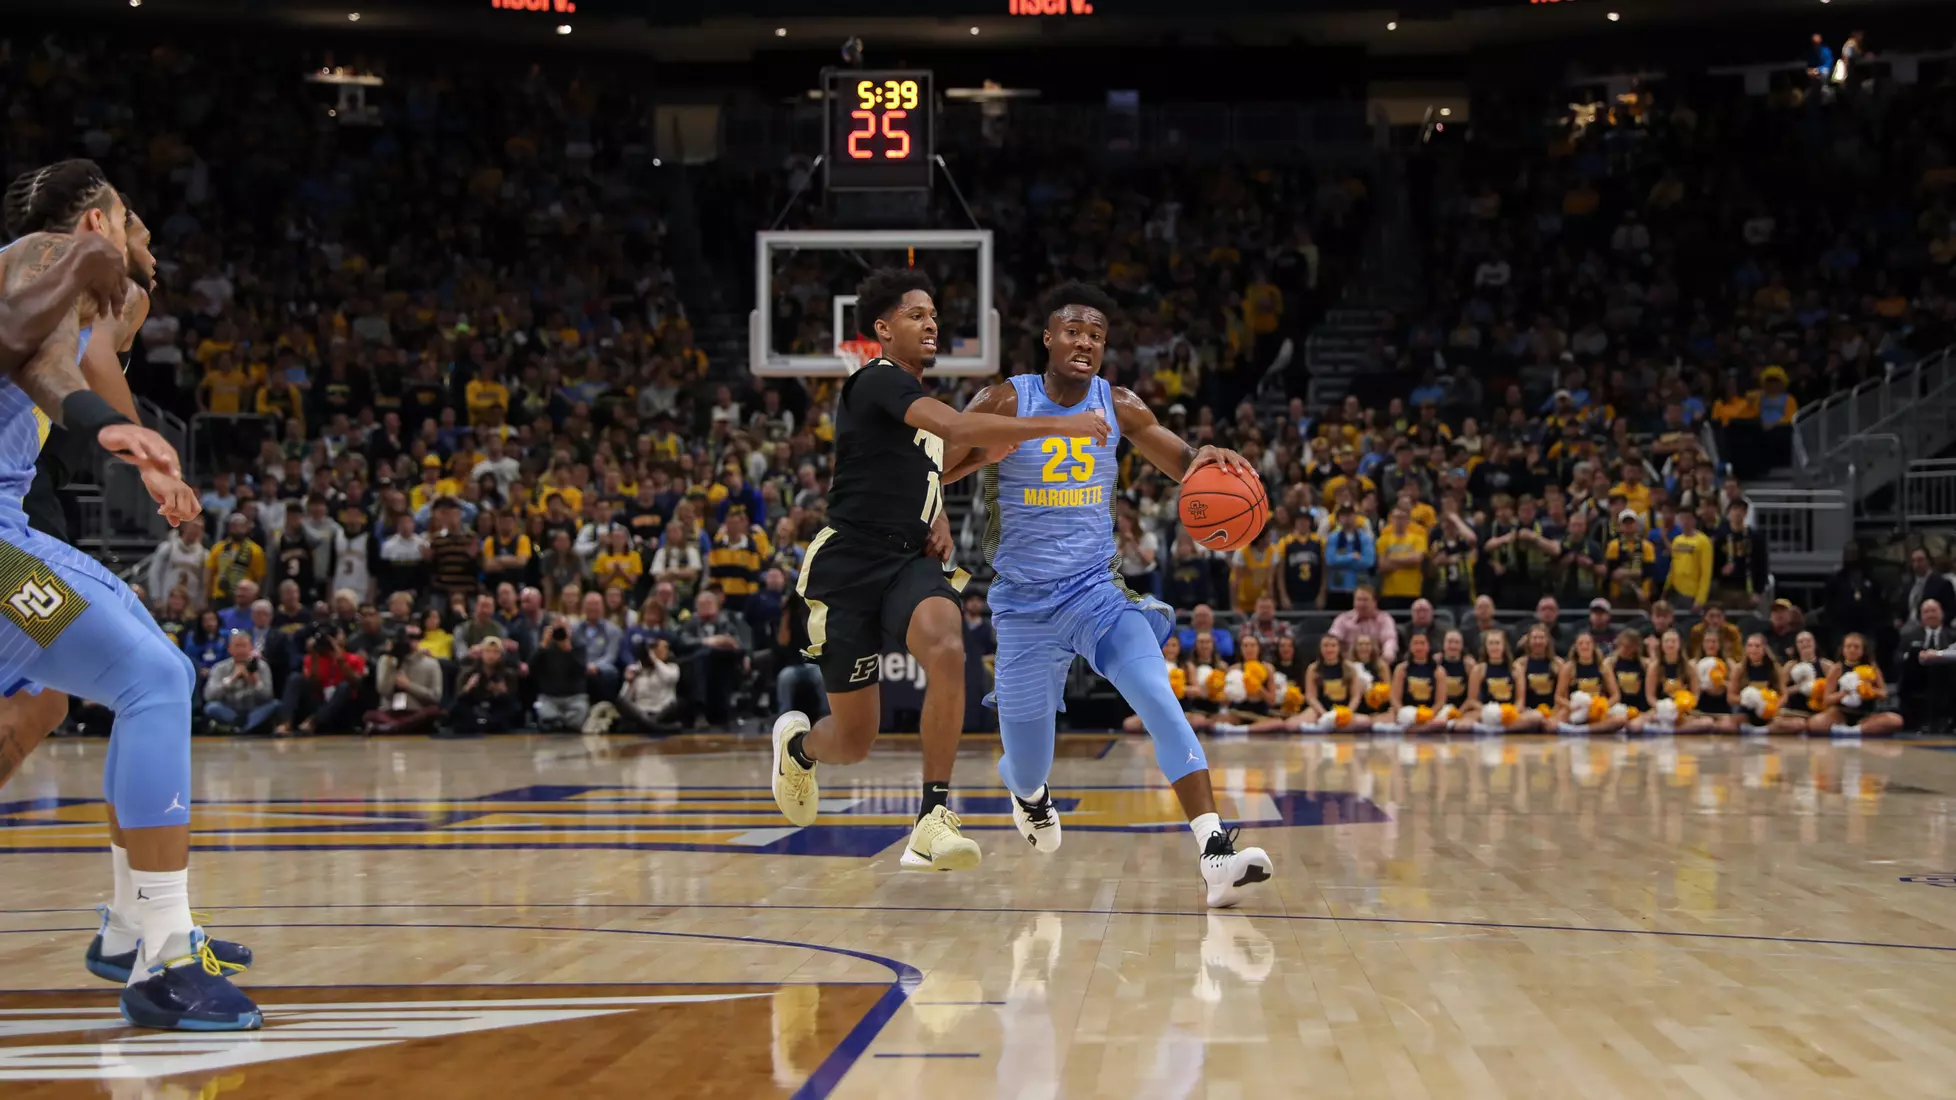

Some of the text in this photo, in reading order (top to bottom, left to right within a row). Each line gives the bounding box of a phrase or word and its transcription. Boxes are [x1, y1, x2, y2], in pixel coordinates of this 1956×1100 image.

[857, 80, 918, 110] 5:39
[848, 110, 911, 159] 25
[1041, 436, 1096, 483] 25
[1024, 485, 1103, 507] MARQUETTE
[4, 575, 67, 622] MU
